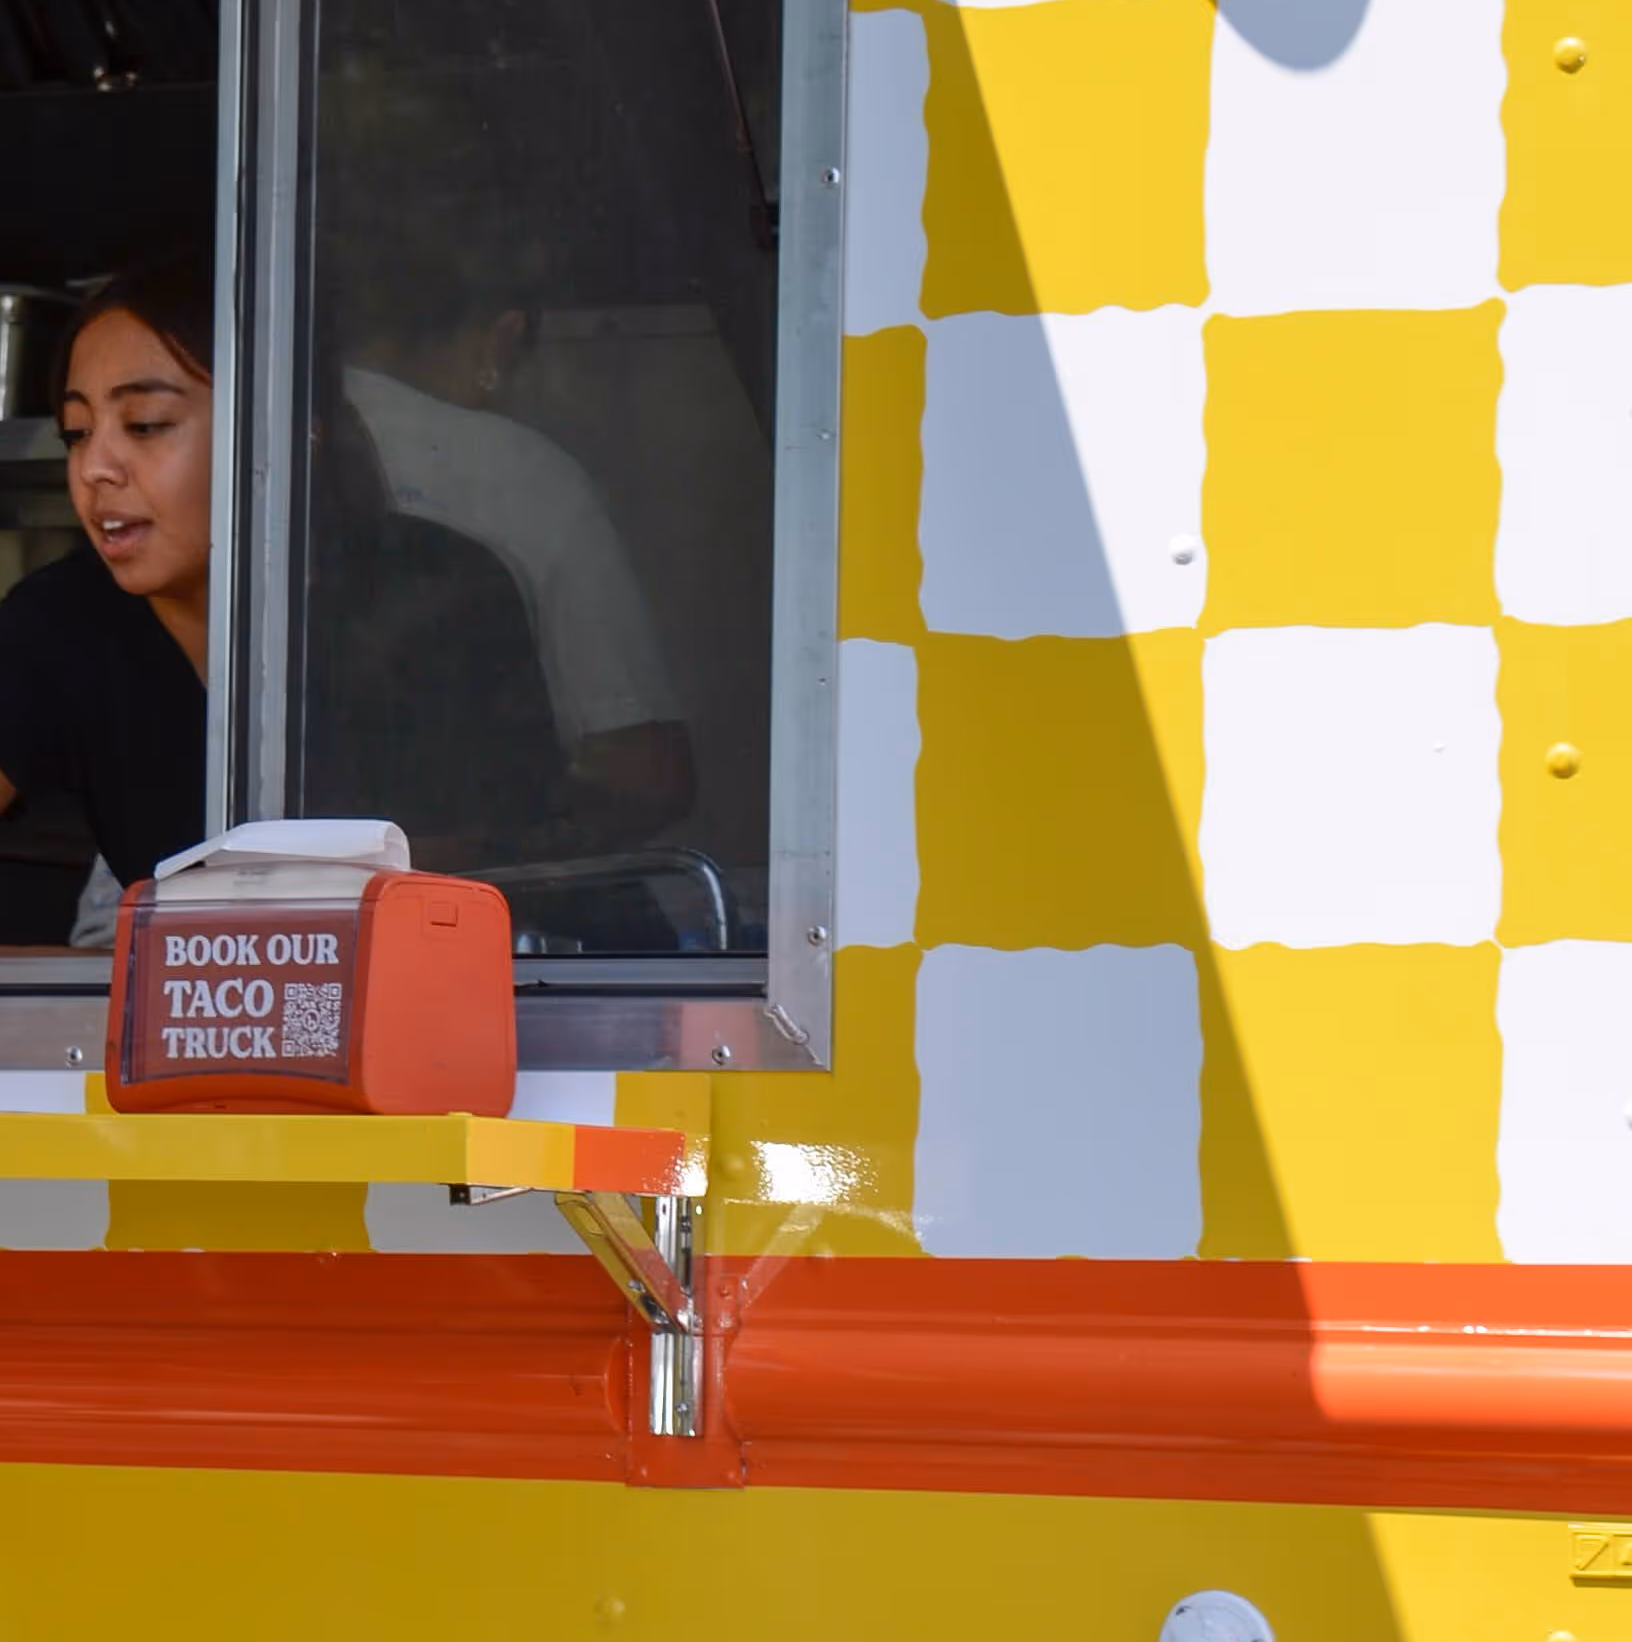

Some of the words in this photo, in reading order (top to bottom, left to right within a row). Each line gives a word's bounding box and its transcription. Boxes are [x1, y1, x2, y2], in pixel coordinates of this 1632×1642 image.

[165, 933, 260, 966] BOOK
[267, 933, 340, 966] OUR
[164, 978, 275, 1019] TACO
[162, 1025, 277, 1059] TRUCK
